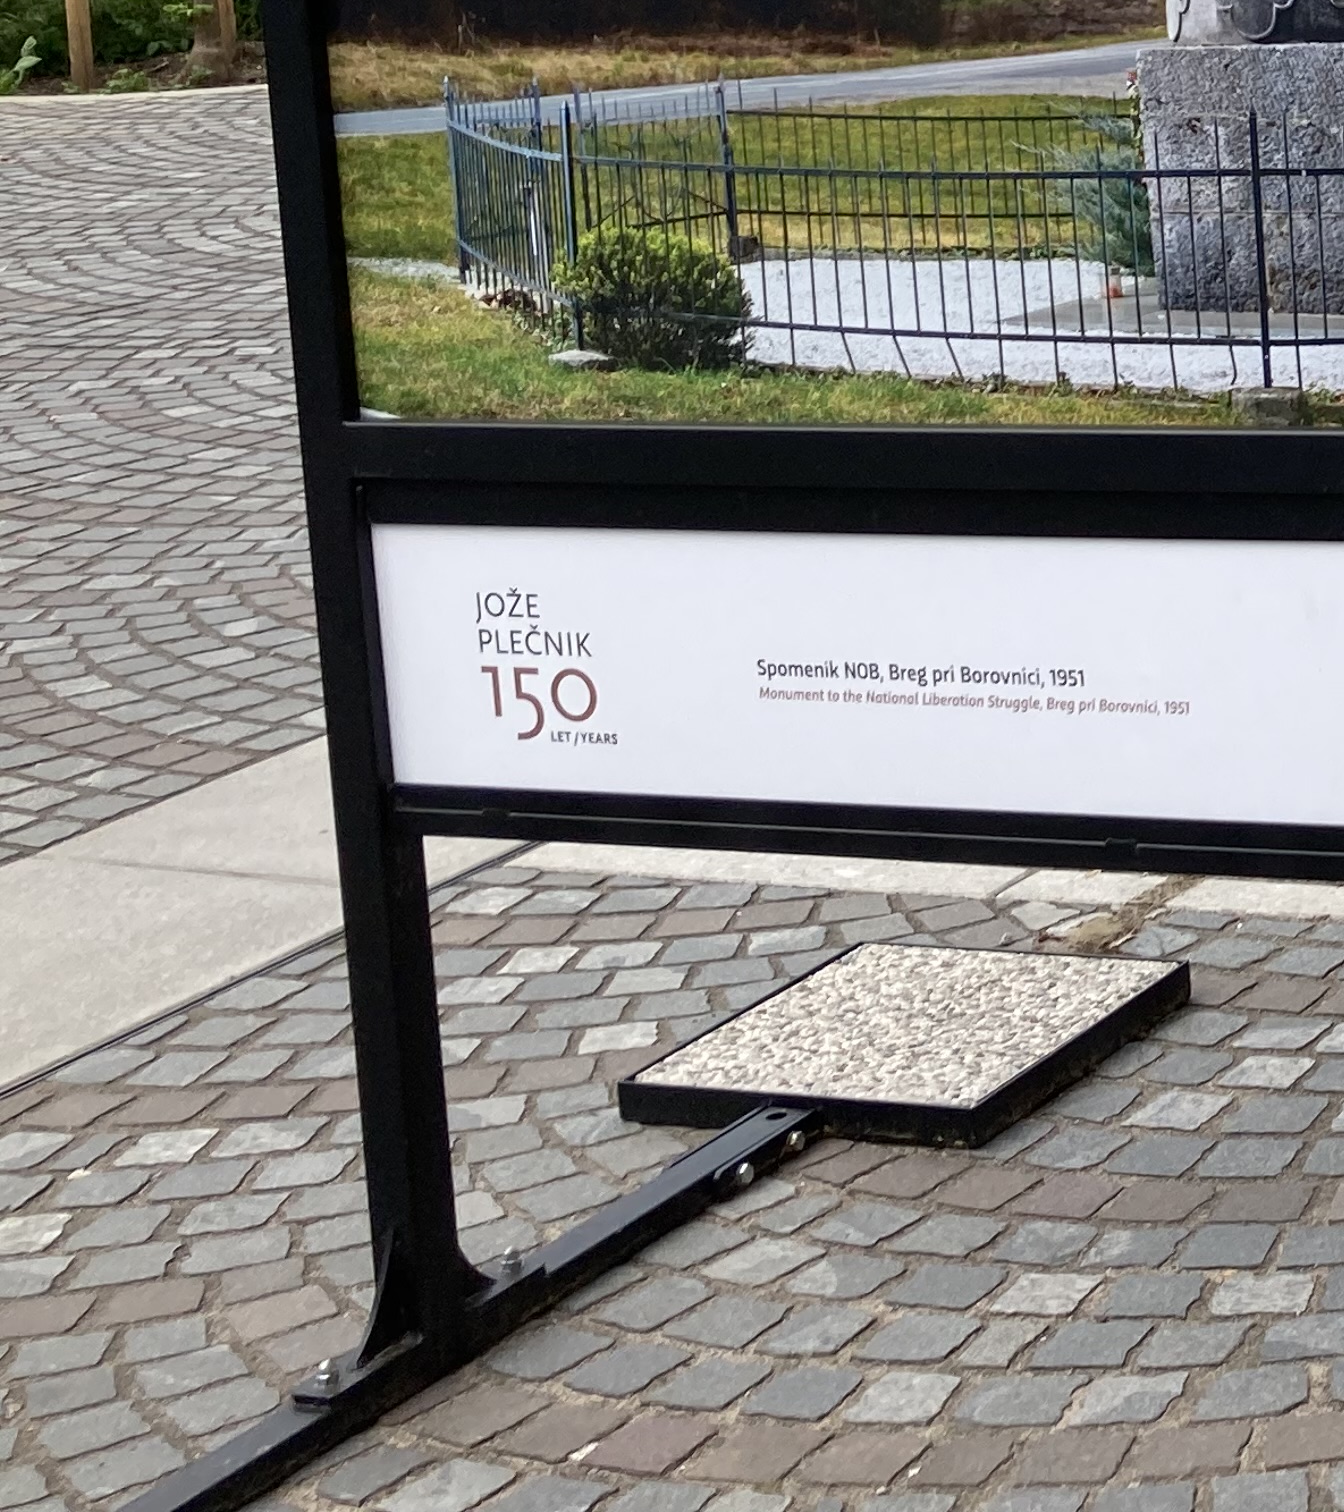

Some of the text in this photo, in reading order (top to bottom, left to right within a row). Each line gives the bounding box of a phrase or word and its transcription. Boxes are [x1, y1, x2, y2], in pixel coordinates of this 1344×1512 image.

[475, 587, 541, 624] JOŽE
[478, 624, 592, 658] PLEČNIK
[756, 659, 840, 685] Spomenik
[888, 662, 928, 688] Breg
[931, 663, 955, 689] pri
[1048, 666, 1085, 687] 1951
[480, 665, 598, 740] 150
[759, 685, 824, 702] Monument
[827, 687, 839, 703] to
[842, 688, 862, 703] the
[865, 688, 919, 705] National
[922, 690, 984, 708] Liberation
[1046, 695, 1075, 715] Breg
[1078, 696, 1095, 715] pri
[1164, 698, 1189, 714] 1951
